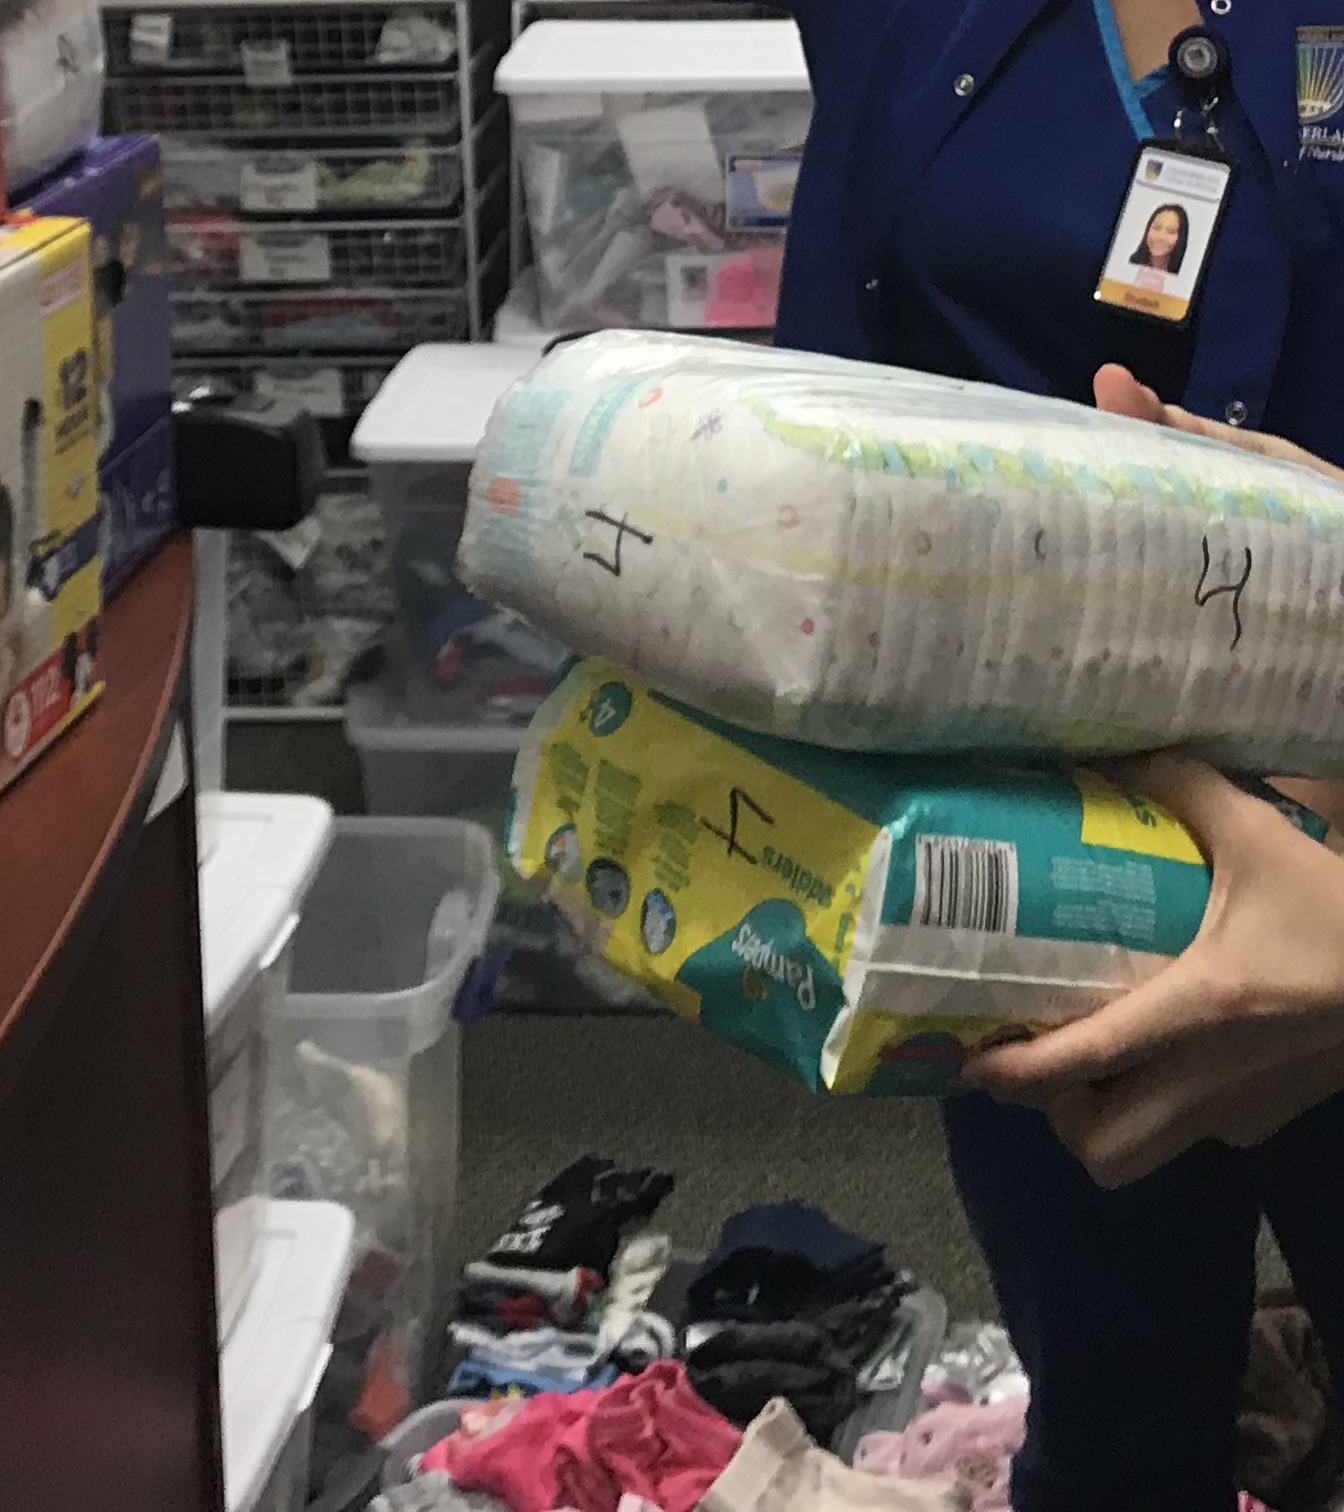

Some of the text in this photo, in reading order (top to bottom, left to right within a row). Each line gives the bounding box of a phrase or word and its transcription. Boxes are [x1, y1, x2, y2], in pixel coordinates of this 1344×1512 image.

[583, 508, 654, 578] 4
[1194, 533, 1253, 652] 4
[732, 923, 817, 1012] Pampers
